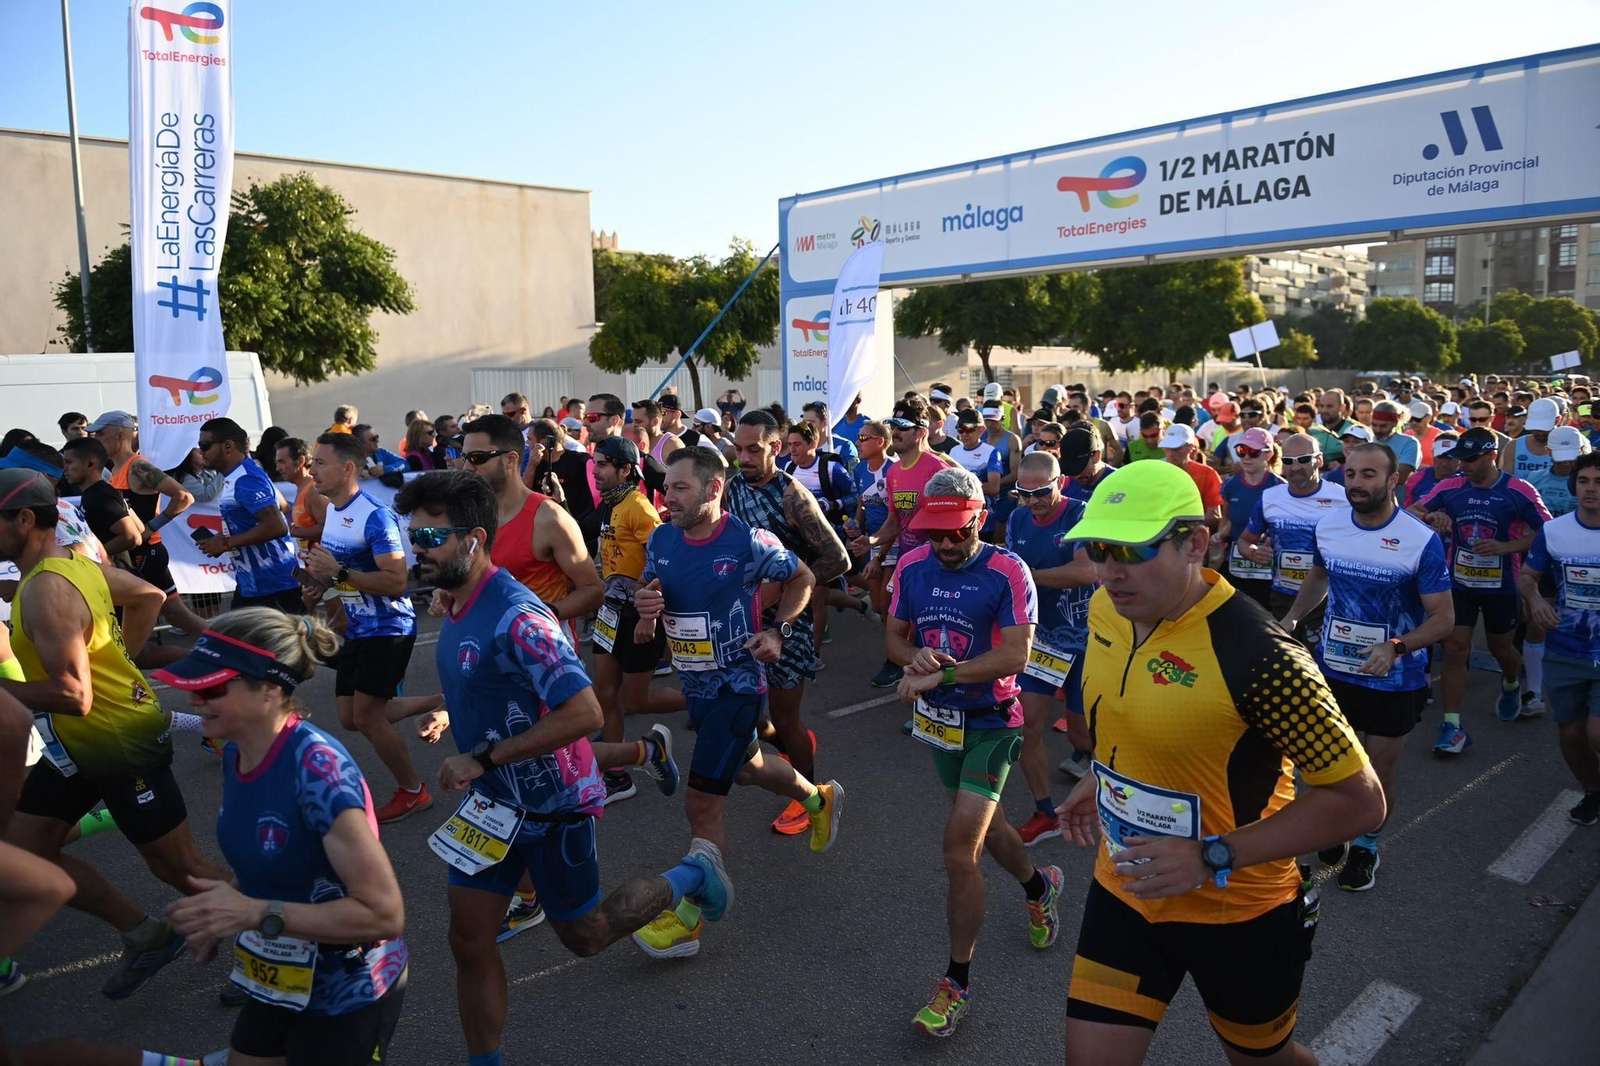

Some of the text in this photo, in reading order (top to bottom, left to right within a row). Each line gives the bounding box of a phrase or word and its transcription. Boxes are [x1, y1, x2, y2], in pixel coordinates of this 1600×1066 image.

[142, 50, 226, 66] TotalEnergies
[1159, 131, 1335, 182] 1/2 MARATÓN
[1393, 156, 1539, 186] Diputación Provincial
[187, 113, 216, 271] LasCarreras
[1160, 174, 1312, 216] DE MÁLAGA
[1427, 179, 1500, 196] de Málaga
[942, 203, 1023, 231] málaga
[1056, 217, 1147, 238] TotalEnergies
[816, 232, 836, 241] metro
[792, 348, 828, 358] TotalEnerg
[793, 375, 828, 395] málag
[1274, 518, 1284, 529] 31
[1324, 558, 1392, 576] 31 TotalEnergies
[1342, 569, 1367, 579] MARATÓN
[1368, 573, 1390, 582] MÁLAGA
[1464, 568, 1489, 577] 2045
[672, 640, 697, 654] 2043
[1035, 653, 1054, 668] 871
[924, 720, 944, 738] 216
[1145, 818, 1172, 830] MÁLAGA
[1146, 812, 1176, 823] MARATÓN
[461, 826, 490, 851] 1817
[250, 958, 279, 986] 952
